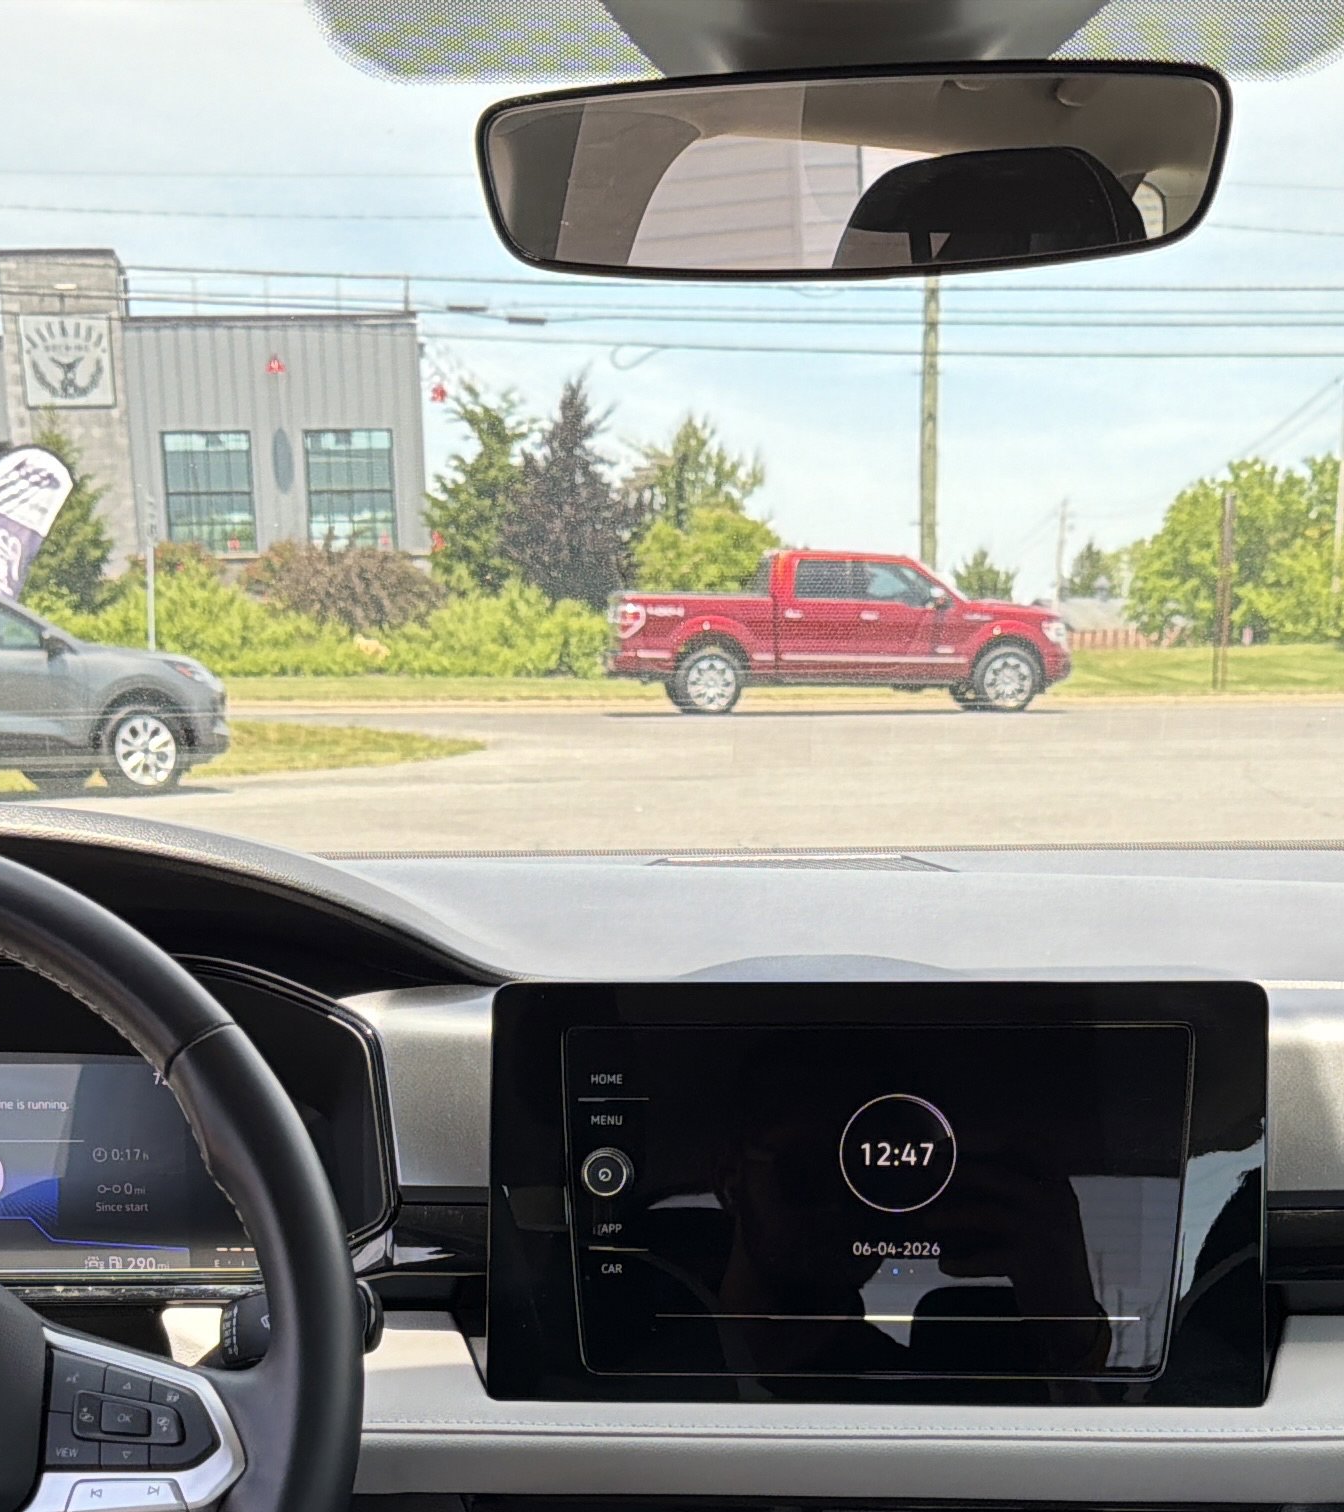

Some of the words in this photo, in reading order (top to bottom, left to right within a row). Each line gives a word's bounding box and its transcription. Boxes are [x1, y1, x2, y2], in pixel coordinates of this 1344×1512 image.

[590, 1074, 623, 1085] HOME
[17, 1099, 26, 1110] is
[28, 1099, 70, 1113] running.
[590, 1114, 623, 1126] MENU
[112, 1148, 141, 1161] 0:17
[860, 1142, 934, 1166] 12:47
[123, 1182, 133, 1195] 0
[95, 1201, 123, 1212] Since
[125, 1201, 149, 1212] start
[600, 1223, 623, 1234] APP
[852, 1241, 941, 1256] 06-04-2026
[127, 1256, 156, 1270] 290
[214, 1259, 221, 1268] E
[600, 1263, 623, 1274] CAR
[117, 1412, 133, 1424] OK
[54, 1446, 80, 1458] VIEW
